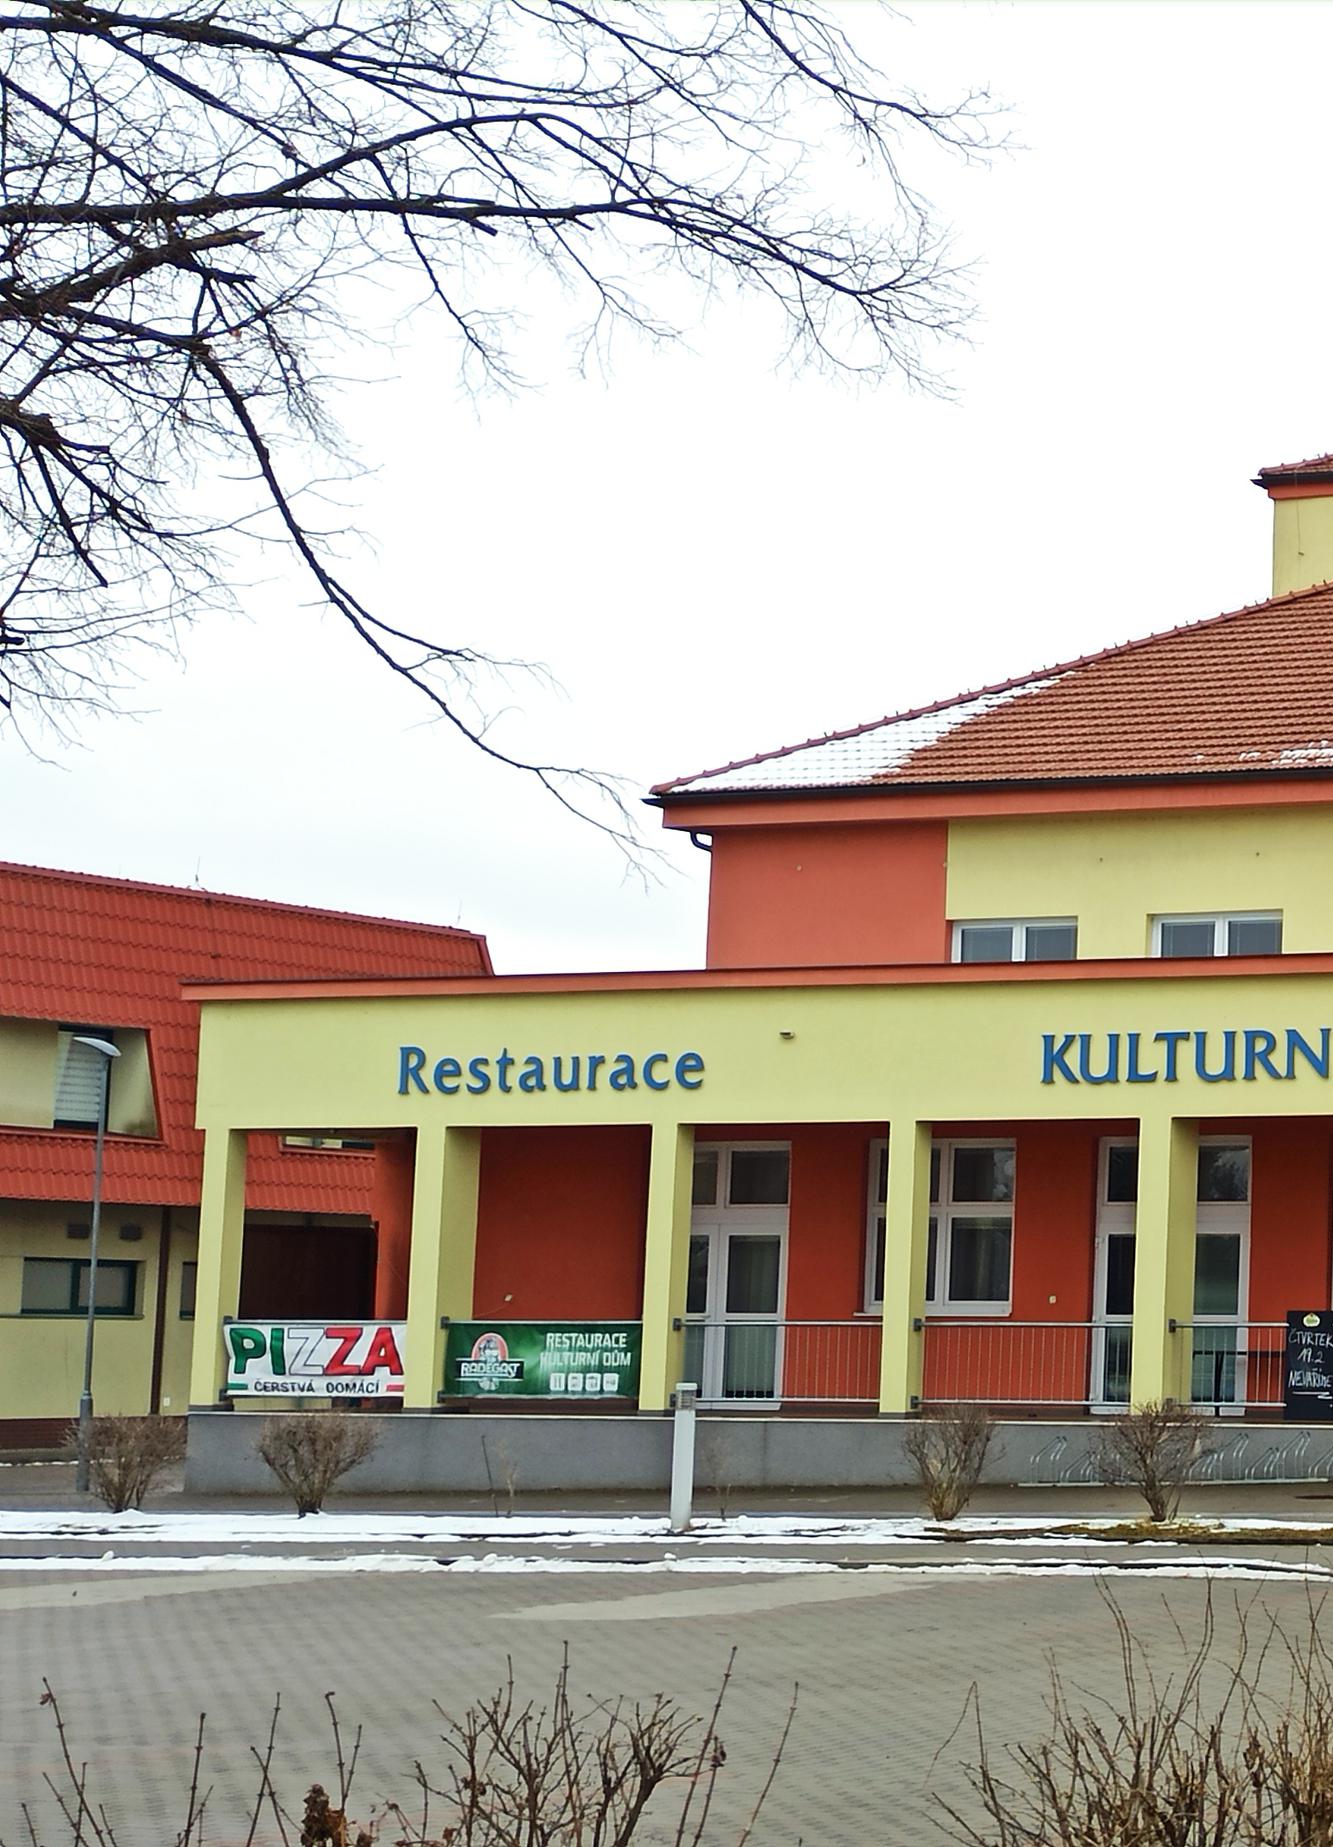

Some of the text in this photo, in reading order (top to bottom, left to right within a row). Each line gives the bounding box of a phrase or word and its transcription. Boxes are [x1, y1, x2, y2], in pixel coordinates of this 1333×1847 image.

[398, 1045, 705, 1095] Restaurace
[546, 1332, 627, 1348] RESTAURACE
[229, 1327, 404, 1376] PIZZA
[602, 1351, 631, 1367] DŮM
[460, 1361, 521, 1378] RADEGAST
[254, 1379, 380, 1393] ČERSTVÁ DOMÁCÍ
